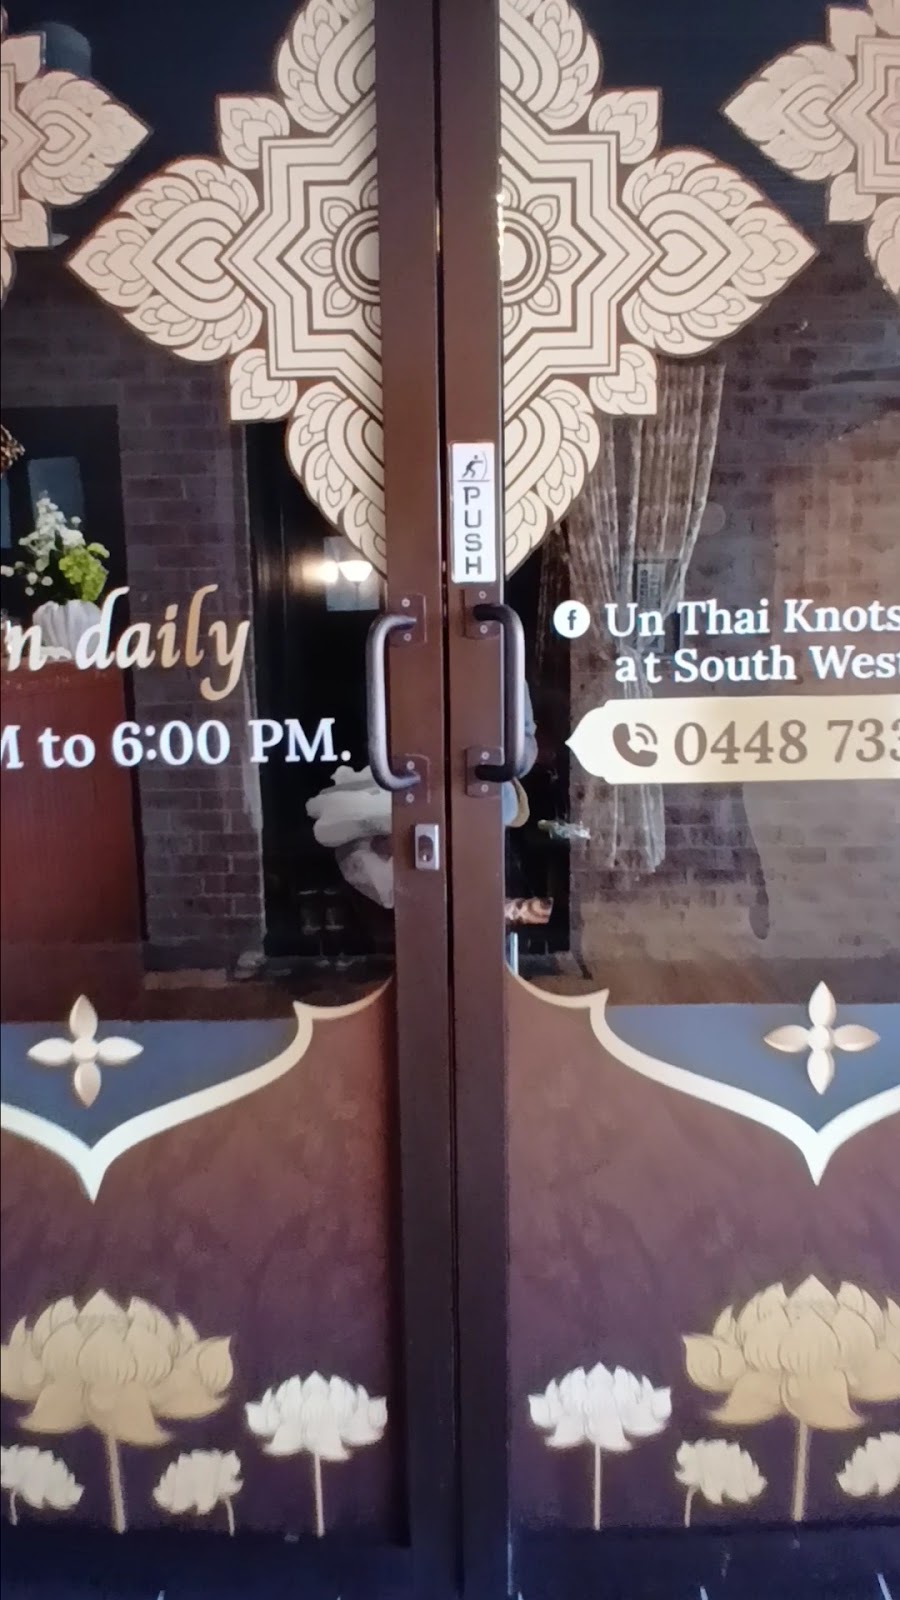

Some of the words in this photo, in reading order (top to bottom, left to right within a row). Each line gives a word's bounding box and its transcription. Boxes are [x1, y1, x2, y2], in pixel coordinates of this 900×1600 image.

[463, 486, 482, 575] PUSH
[604, 602, 666, 637] Un
[677, 597, 770, 636] Thai
[783, 599, 900, 634] Knots
[75, 584, 250, 701] daily
[615, 652, 662, 683] at
[674, 645, 797, 683] South
[808, 645, 900, 681] Wes
[38, 728, 96, 768] to
[111, 719, 231, 767] 6:00
[247, 717, 352, 763] PM.
[674, 719, 808, 766] 0448
